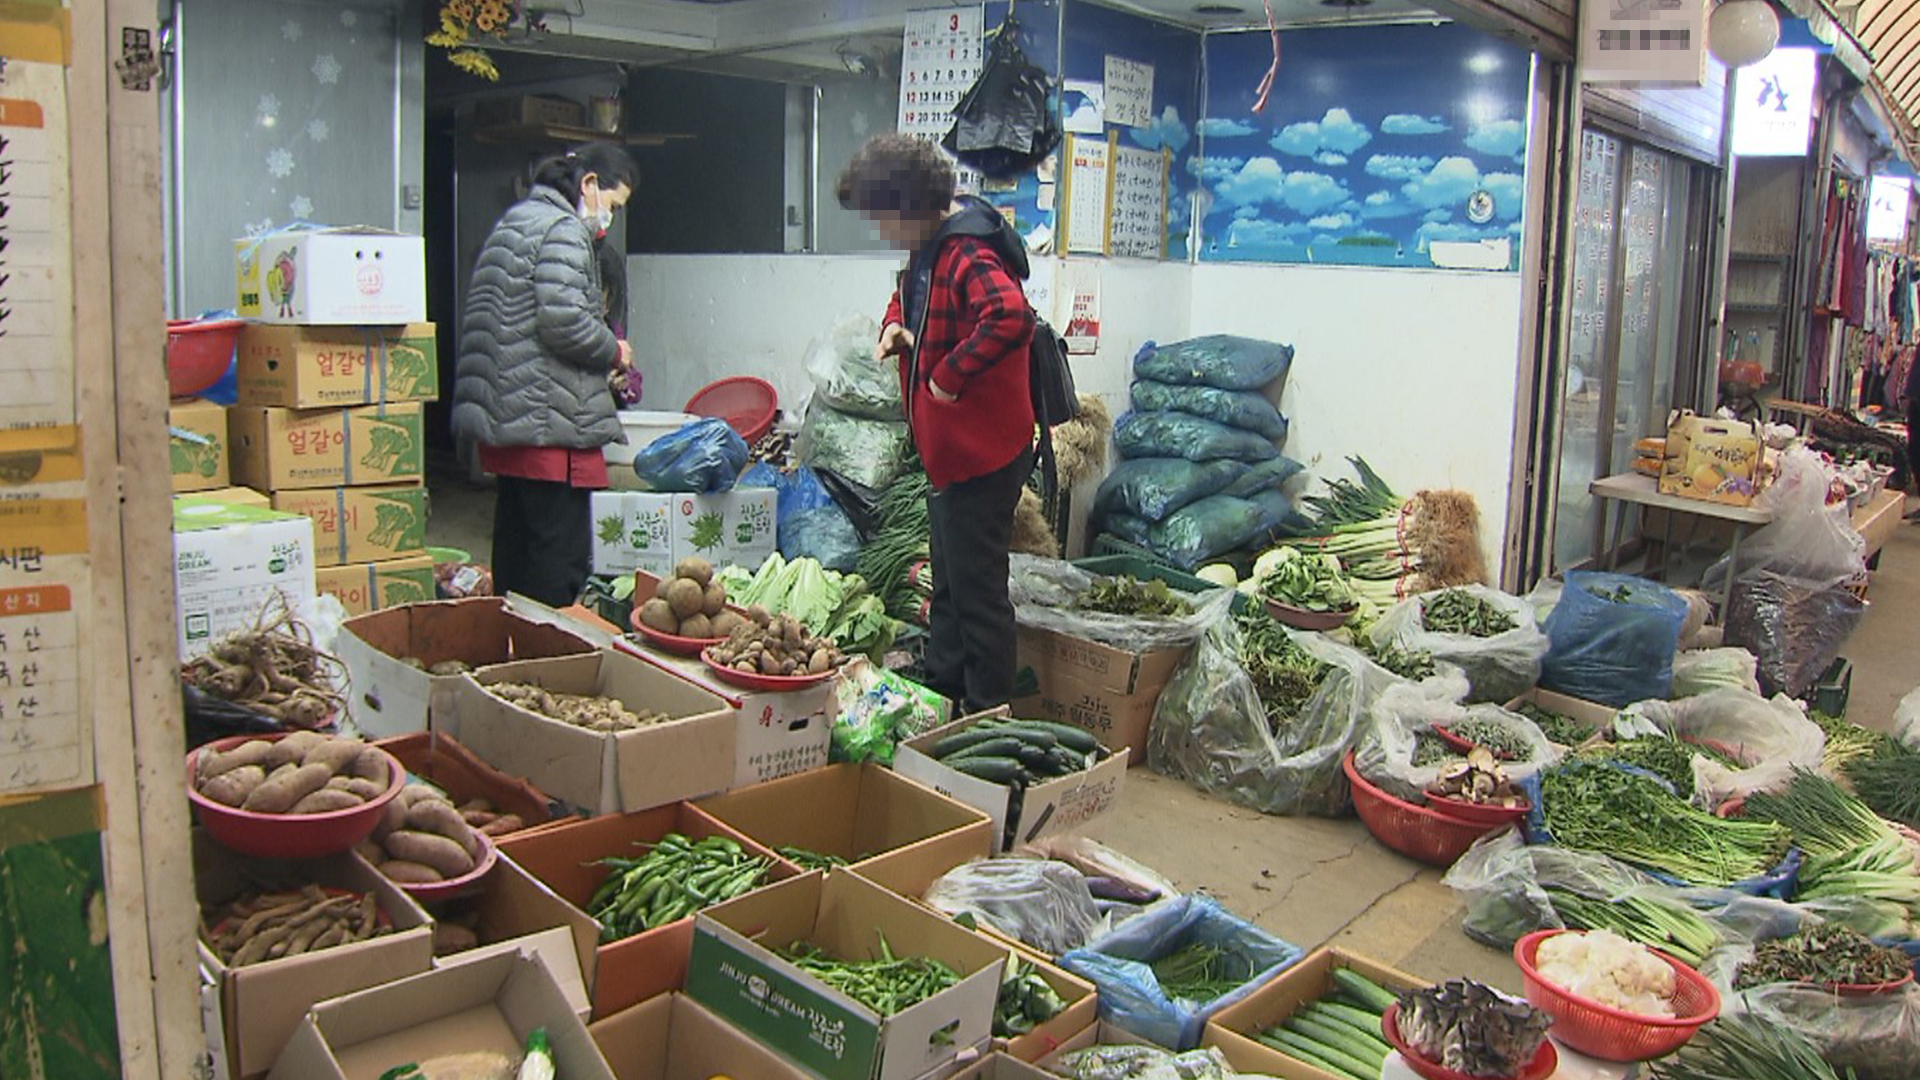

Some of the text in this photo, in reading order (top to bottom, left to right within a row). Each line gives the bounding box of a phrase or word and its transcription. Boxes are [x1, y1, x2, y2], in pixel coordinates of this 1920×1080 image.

[948, 14, 959, 32] 3
[949, 48, 982, 60] 1 2 3
[909, 72, 916, 83] 5
[922, 71, 929, 81] 6
[935, 70, 941, 81] 7
[906, 92, 916, 103] 12
[920, 91, 929, 102] 13
[932, 91, 941, 102] 14
[945, 91, 955, 102] 15
[918, 112, 929, 123] 20
[931, 112, 941, 122] 21
[317, 351, 375, 378] 얼갈이
[23, 626, 41, 652] 산
[21, 662, 39, 687] 산
[17, 695, 39, 718] 산
[719, 961, 747, 985] JINJU
[770, 991, 805, 1019] DREAM
